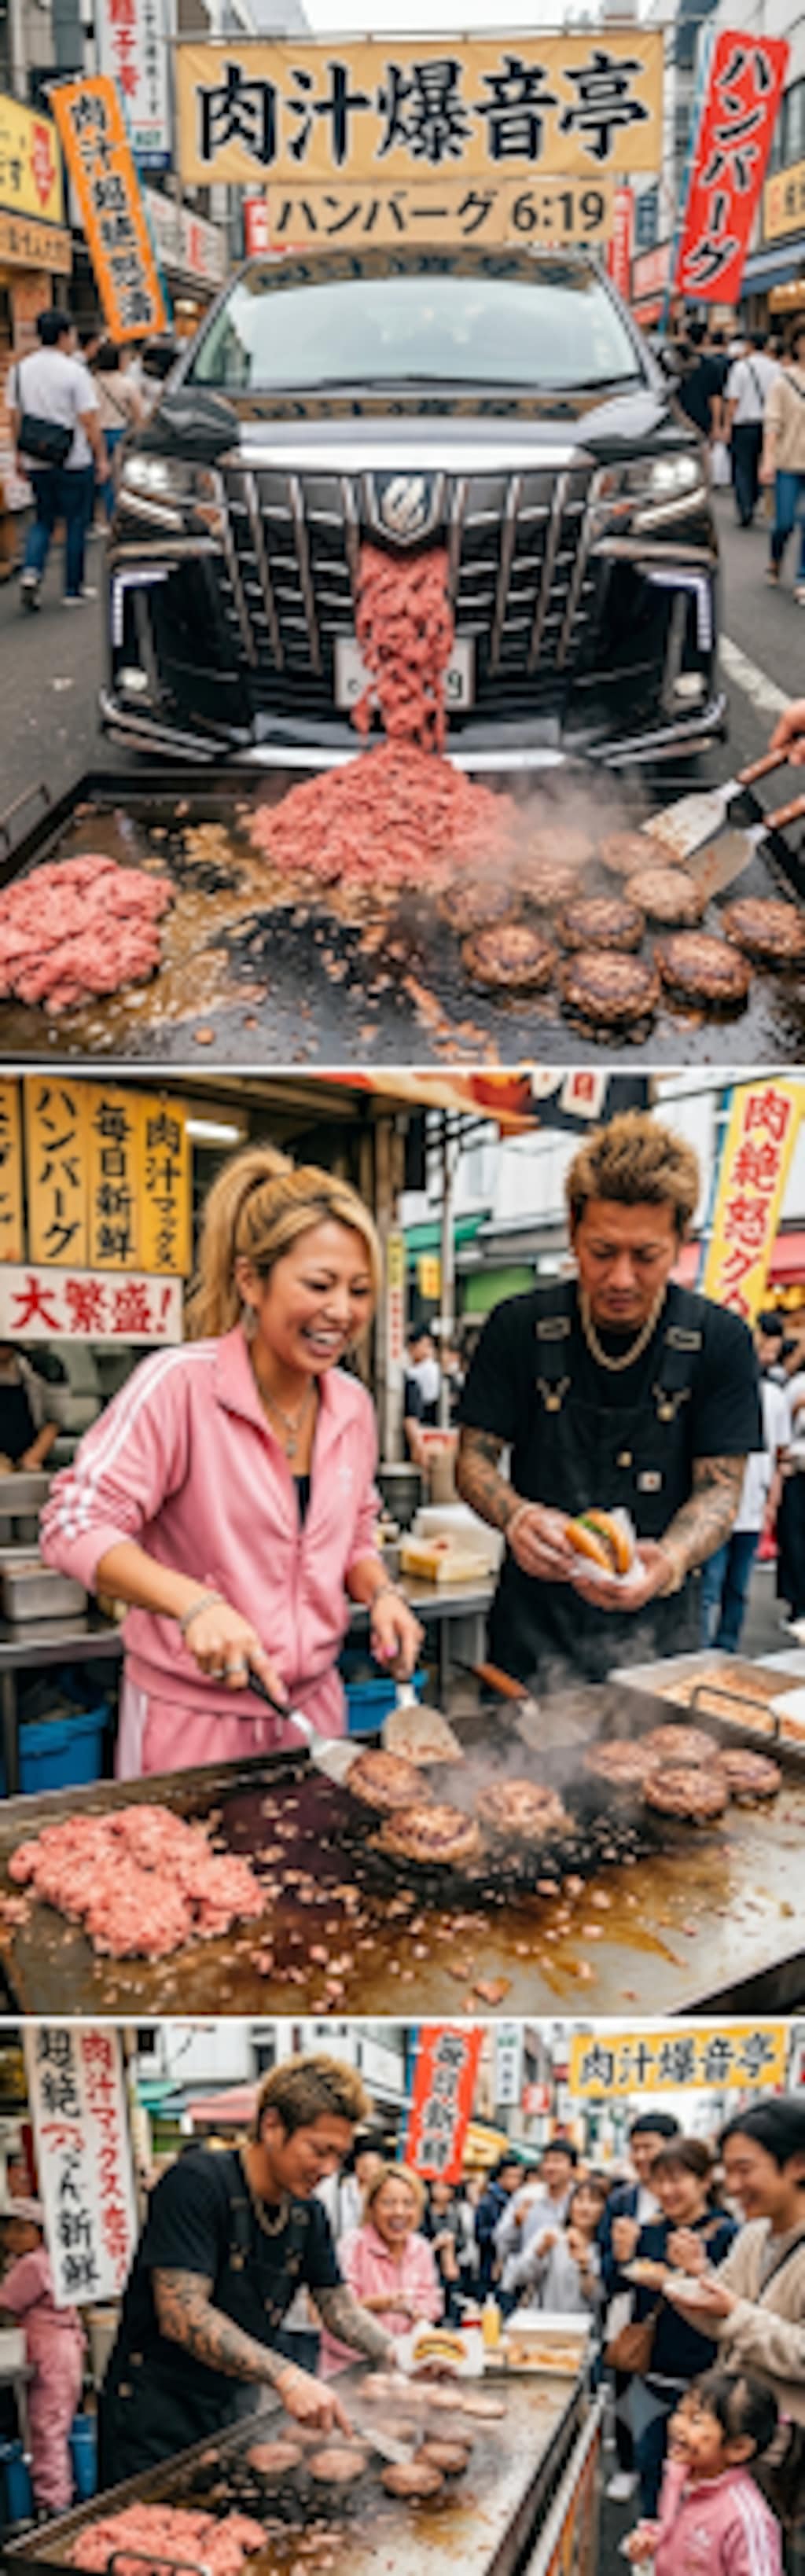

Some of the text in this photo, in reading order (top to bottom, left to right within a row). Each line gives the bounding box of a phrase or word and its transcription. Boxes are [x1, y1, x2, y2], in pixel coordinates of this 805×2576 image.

[197, 52, 649, 167] 肉汁爆音亭
[689, 50, 771, 284] ハンバーグ
[277, 189, 498, 236] ハンバーグ
[512, 191, 605, 232] 6:19
[36, 1087, 80, 1259] ハンバーグ
